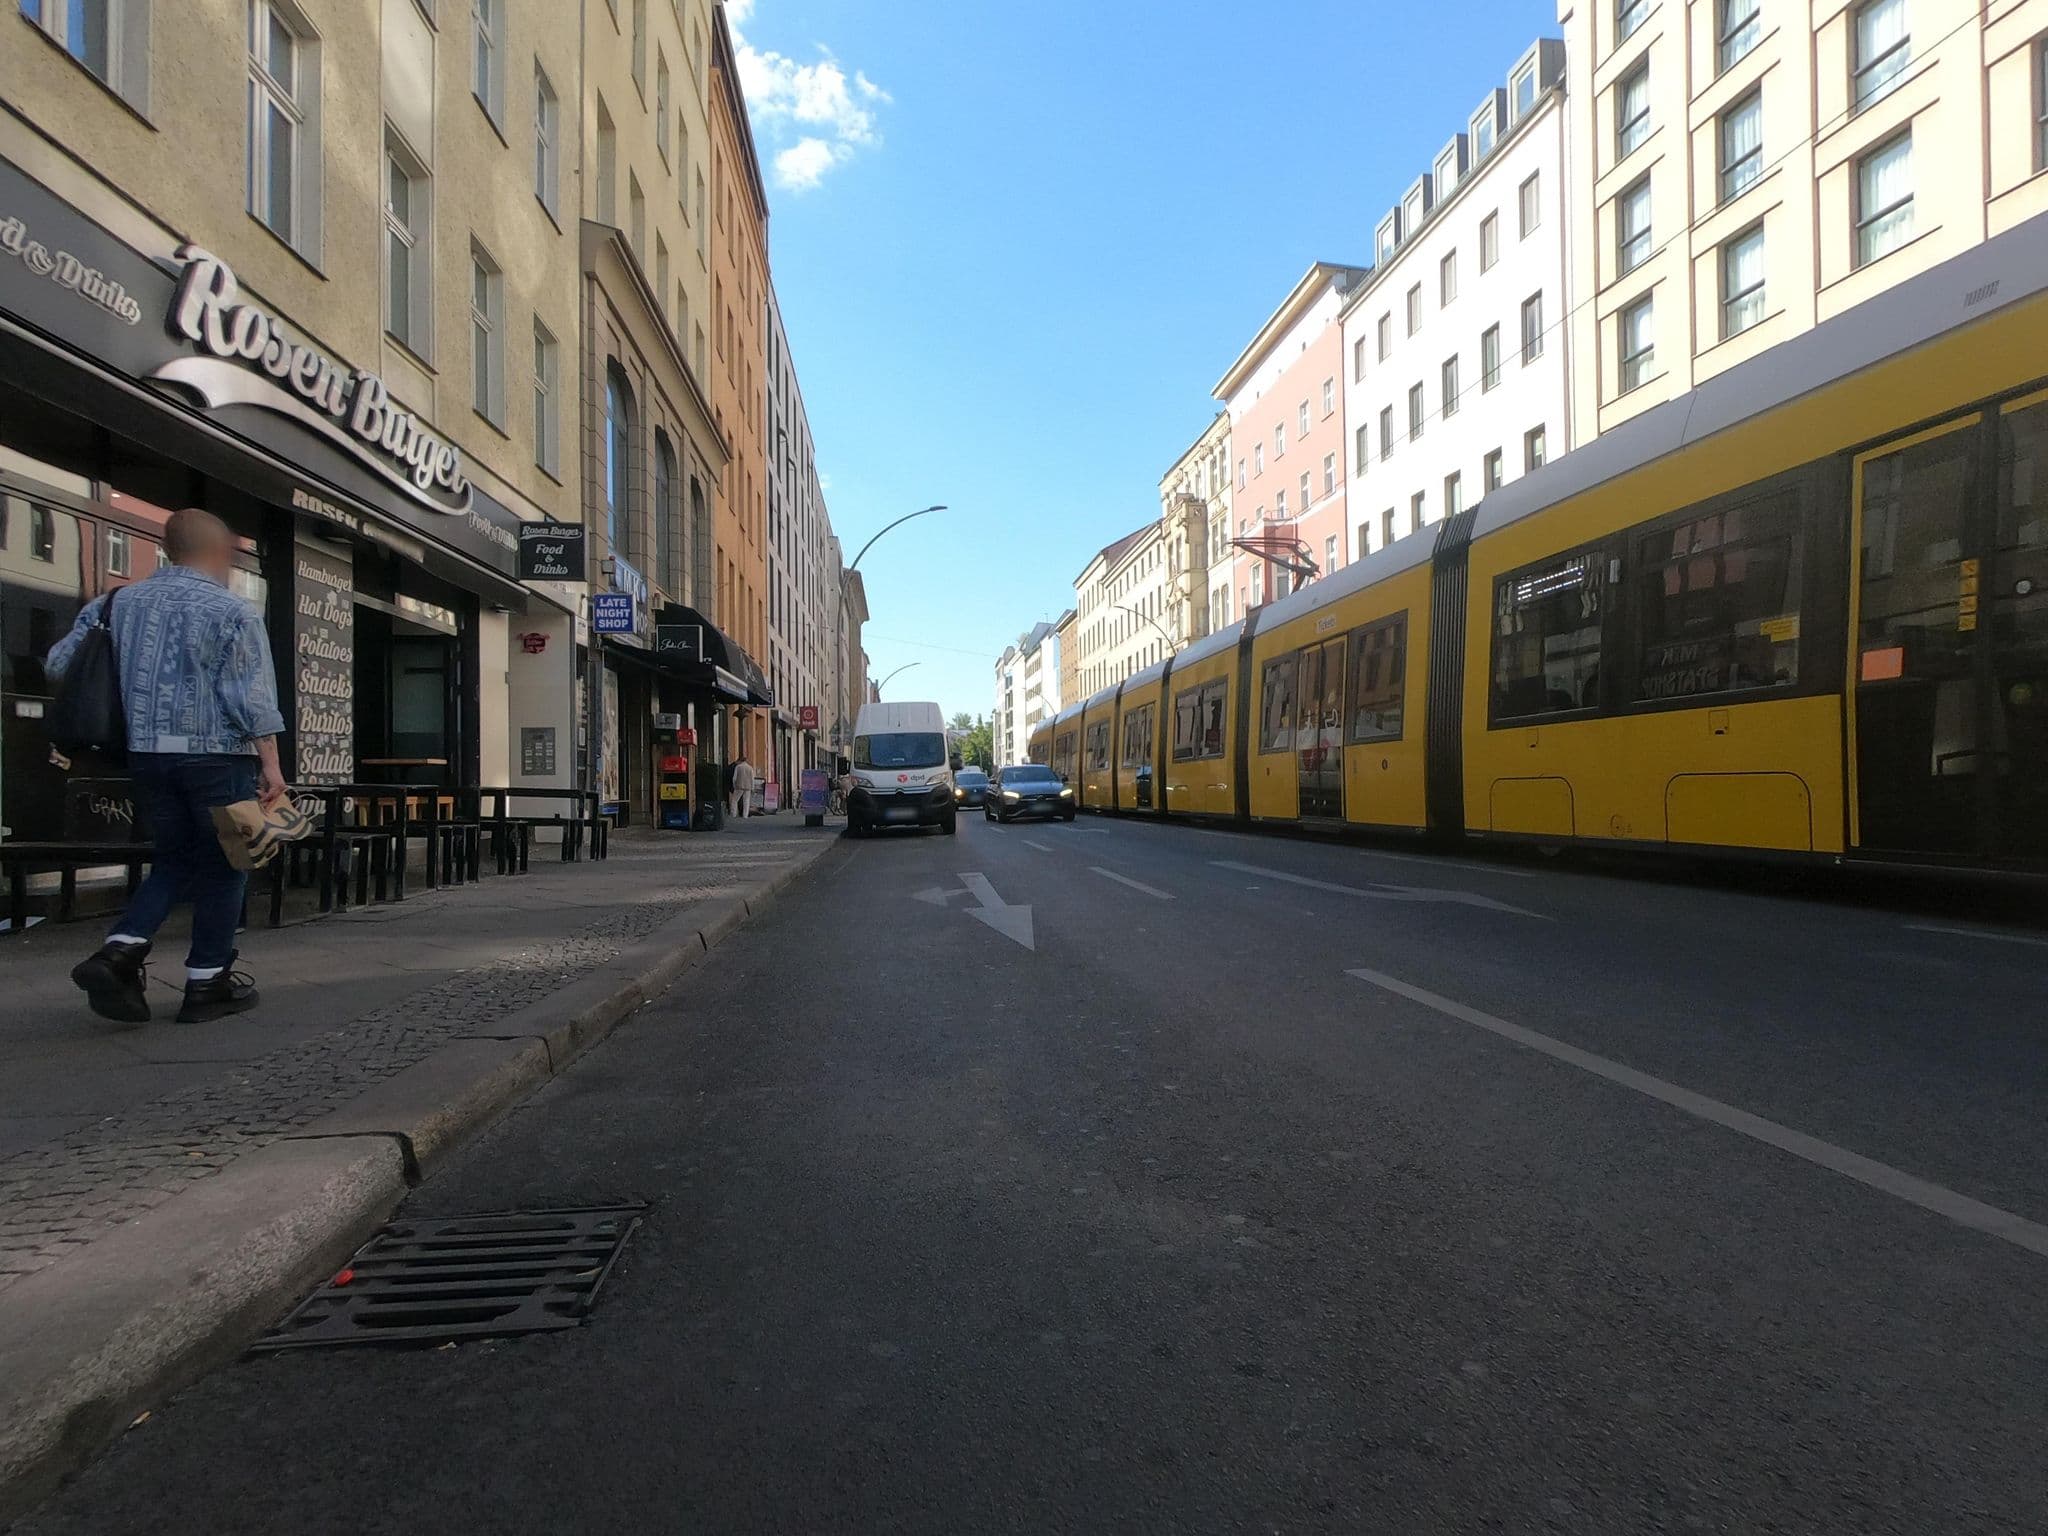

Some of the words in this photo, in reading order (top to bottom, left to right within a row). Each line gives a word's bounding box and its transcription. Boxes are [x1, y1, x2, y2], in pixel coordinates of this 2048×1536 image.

[168, 243, 348, 417] Rosen
[347, 367, 467, 496] Burger
[522, 525, 549, 536] Rosen
[549, 526, 580, 537] Burger
[535, 544, 565, 554] Food
[544, 554, 555, 563] &
[533, 563, 569, 575] Drinks
[297, 559, 353, 593] Hamburger
[599, 598, 627, 608] LATE
[298, 594, 322, 619] Hot
[322, 601, 353, 631] Dogs
[596, 608, 631, 618] NIGHT
[598, 618, 629, 628] SHOP
[298, 632, 353, 663] Potatoes
[298, 668, 353, 699] Snacks
[299, 746, 353, 774] Salate
[911, 774, 925, 784] dpd
